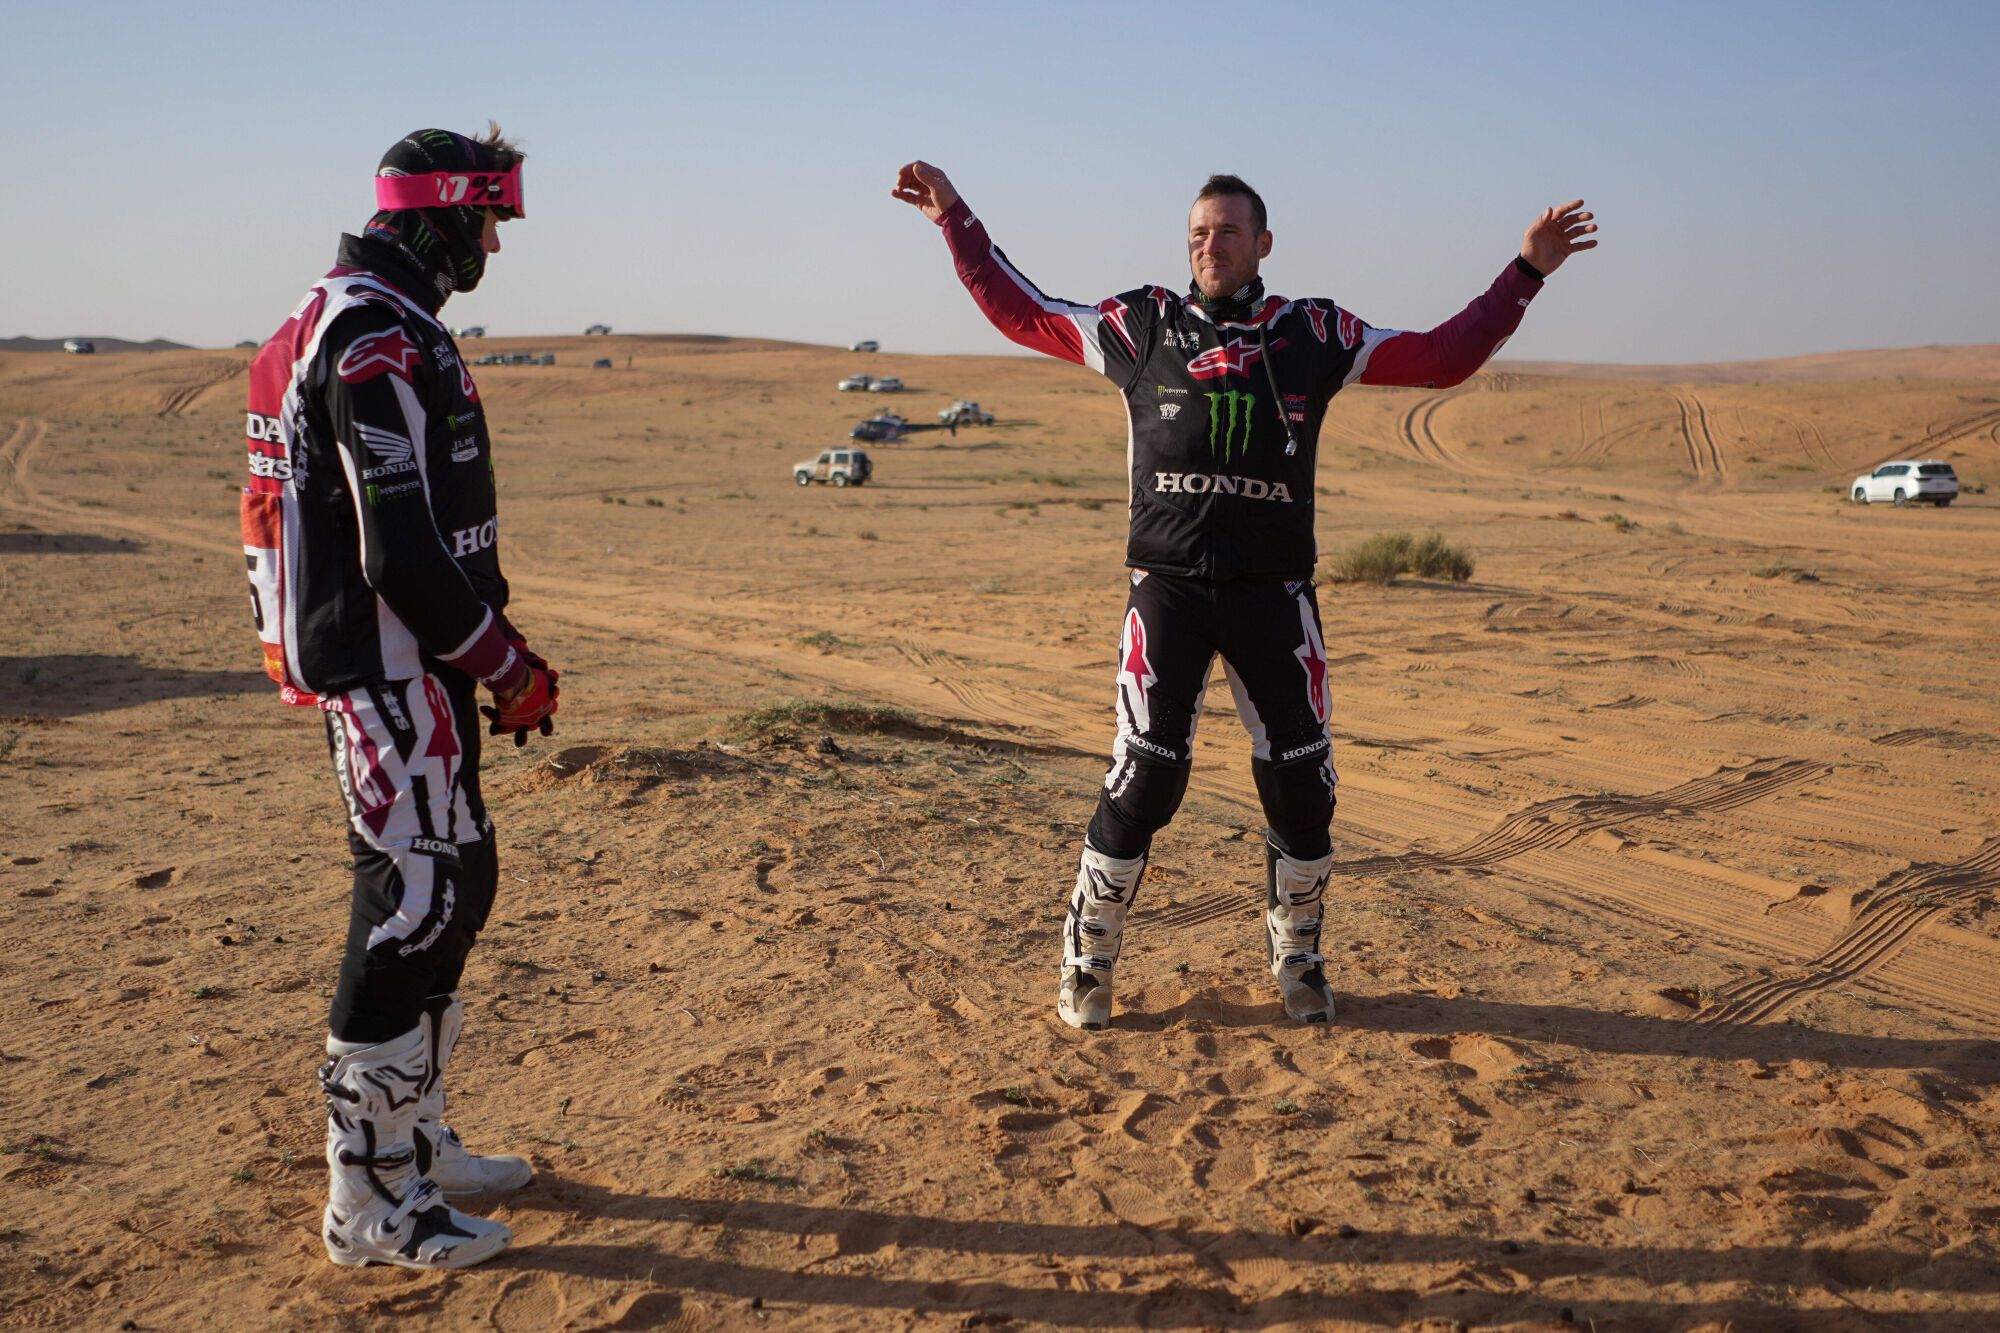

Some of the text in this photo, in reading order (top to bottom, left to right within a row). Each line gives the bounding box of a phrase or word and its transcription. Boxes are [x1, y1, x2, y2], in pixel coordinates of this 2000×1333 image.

[362, 461, 417, 480] HONDA
[1155, 472, 1294, 503] HONDA
[452, 515, 497, 558] HO
[1127, 734, 1177, 761] HONDA
[1281, 738, 1329, 761] HONDA
[412, 837, 460, 858] HOND
